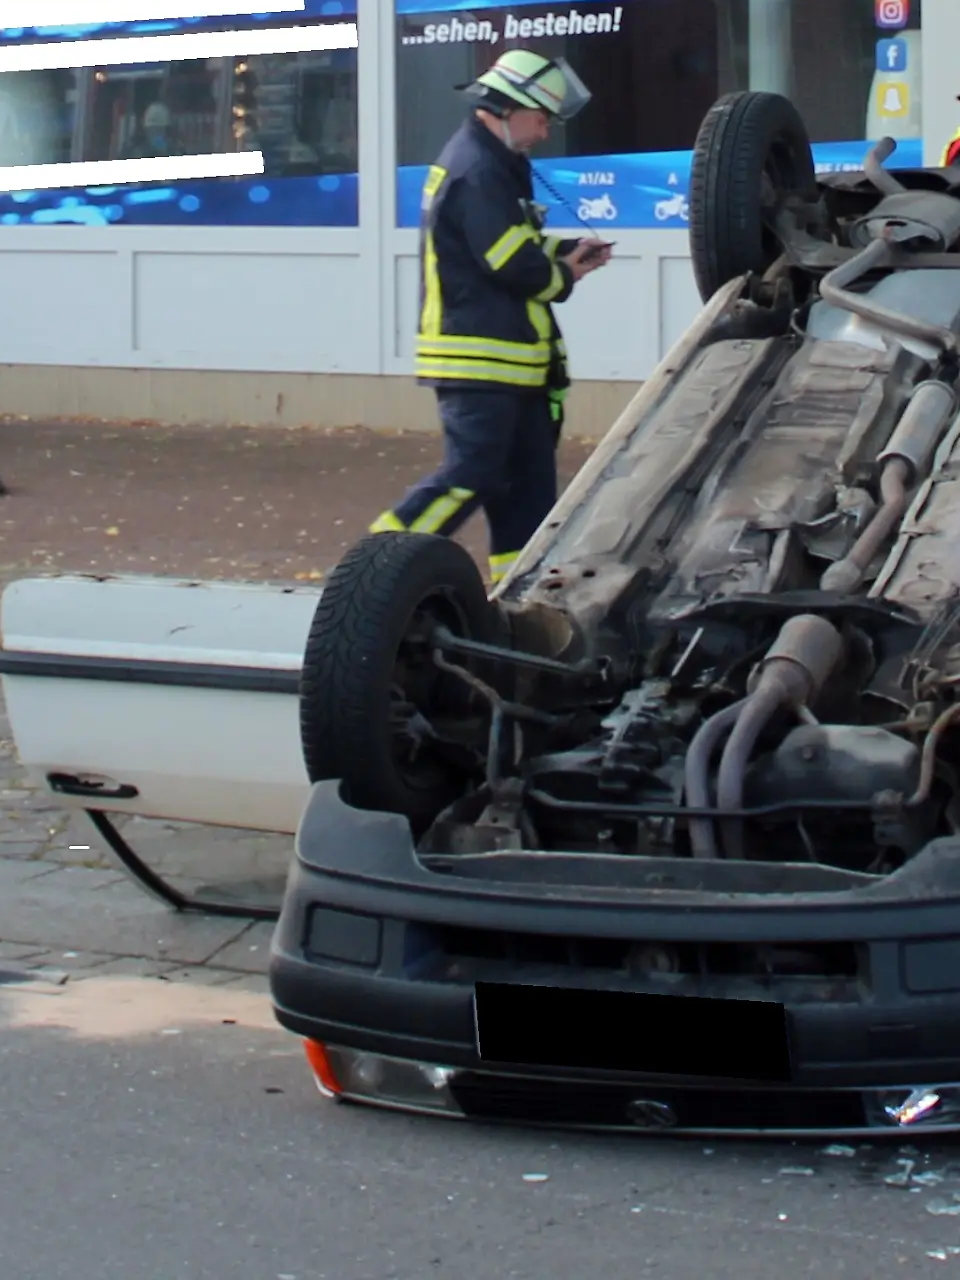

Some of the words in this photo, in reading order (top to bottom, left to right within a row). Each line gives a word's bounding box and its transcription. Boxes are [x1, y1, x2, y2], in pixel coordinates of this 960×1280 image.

[504, 7, 623, 39] bestehen!
[578, 172, 615, 185] A1/A2
[667, 173, 678, 185] A
